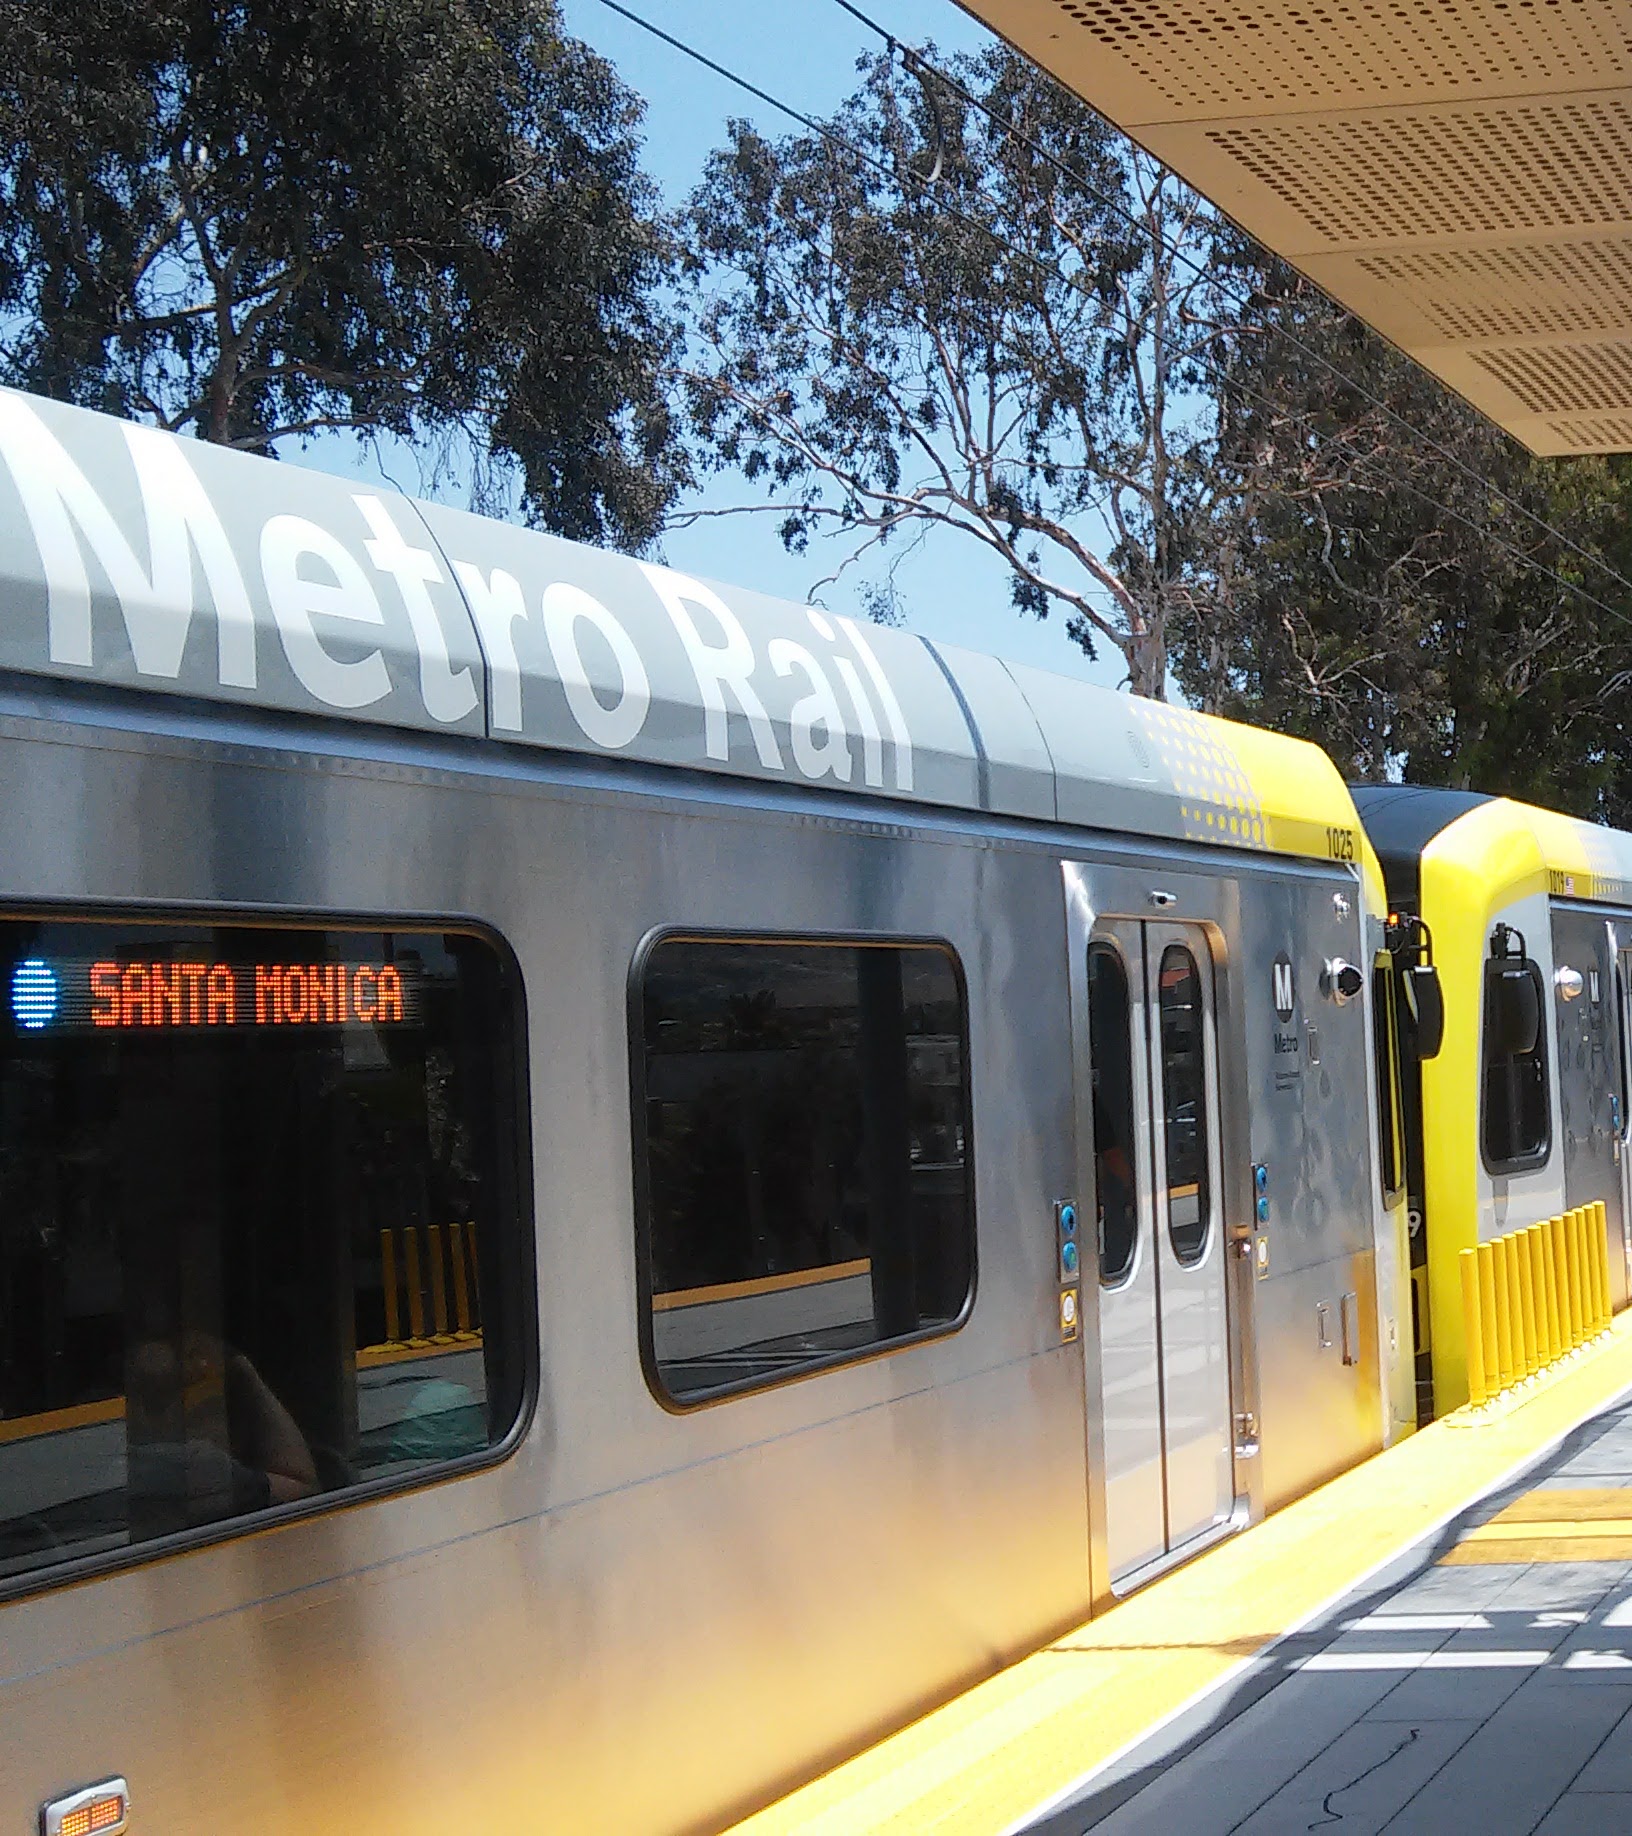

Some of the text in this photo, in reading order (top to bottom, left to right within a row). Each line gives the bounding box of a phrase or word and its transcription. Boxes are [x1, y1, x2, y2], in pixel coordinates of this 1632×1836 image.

[0, 391, 914, 793] Metro Rail
[1326, 826, 1354, 860] 1025
[90, 963, 403, 1026] SANTA MONICA
[1274, 963, 1293, 1010] M
[1274, 1033, 1298, 1055] Metro
